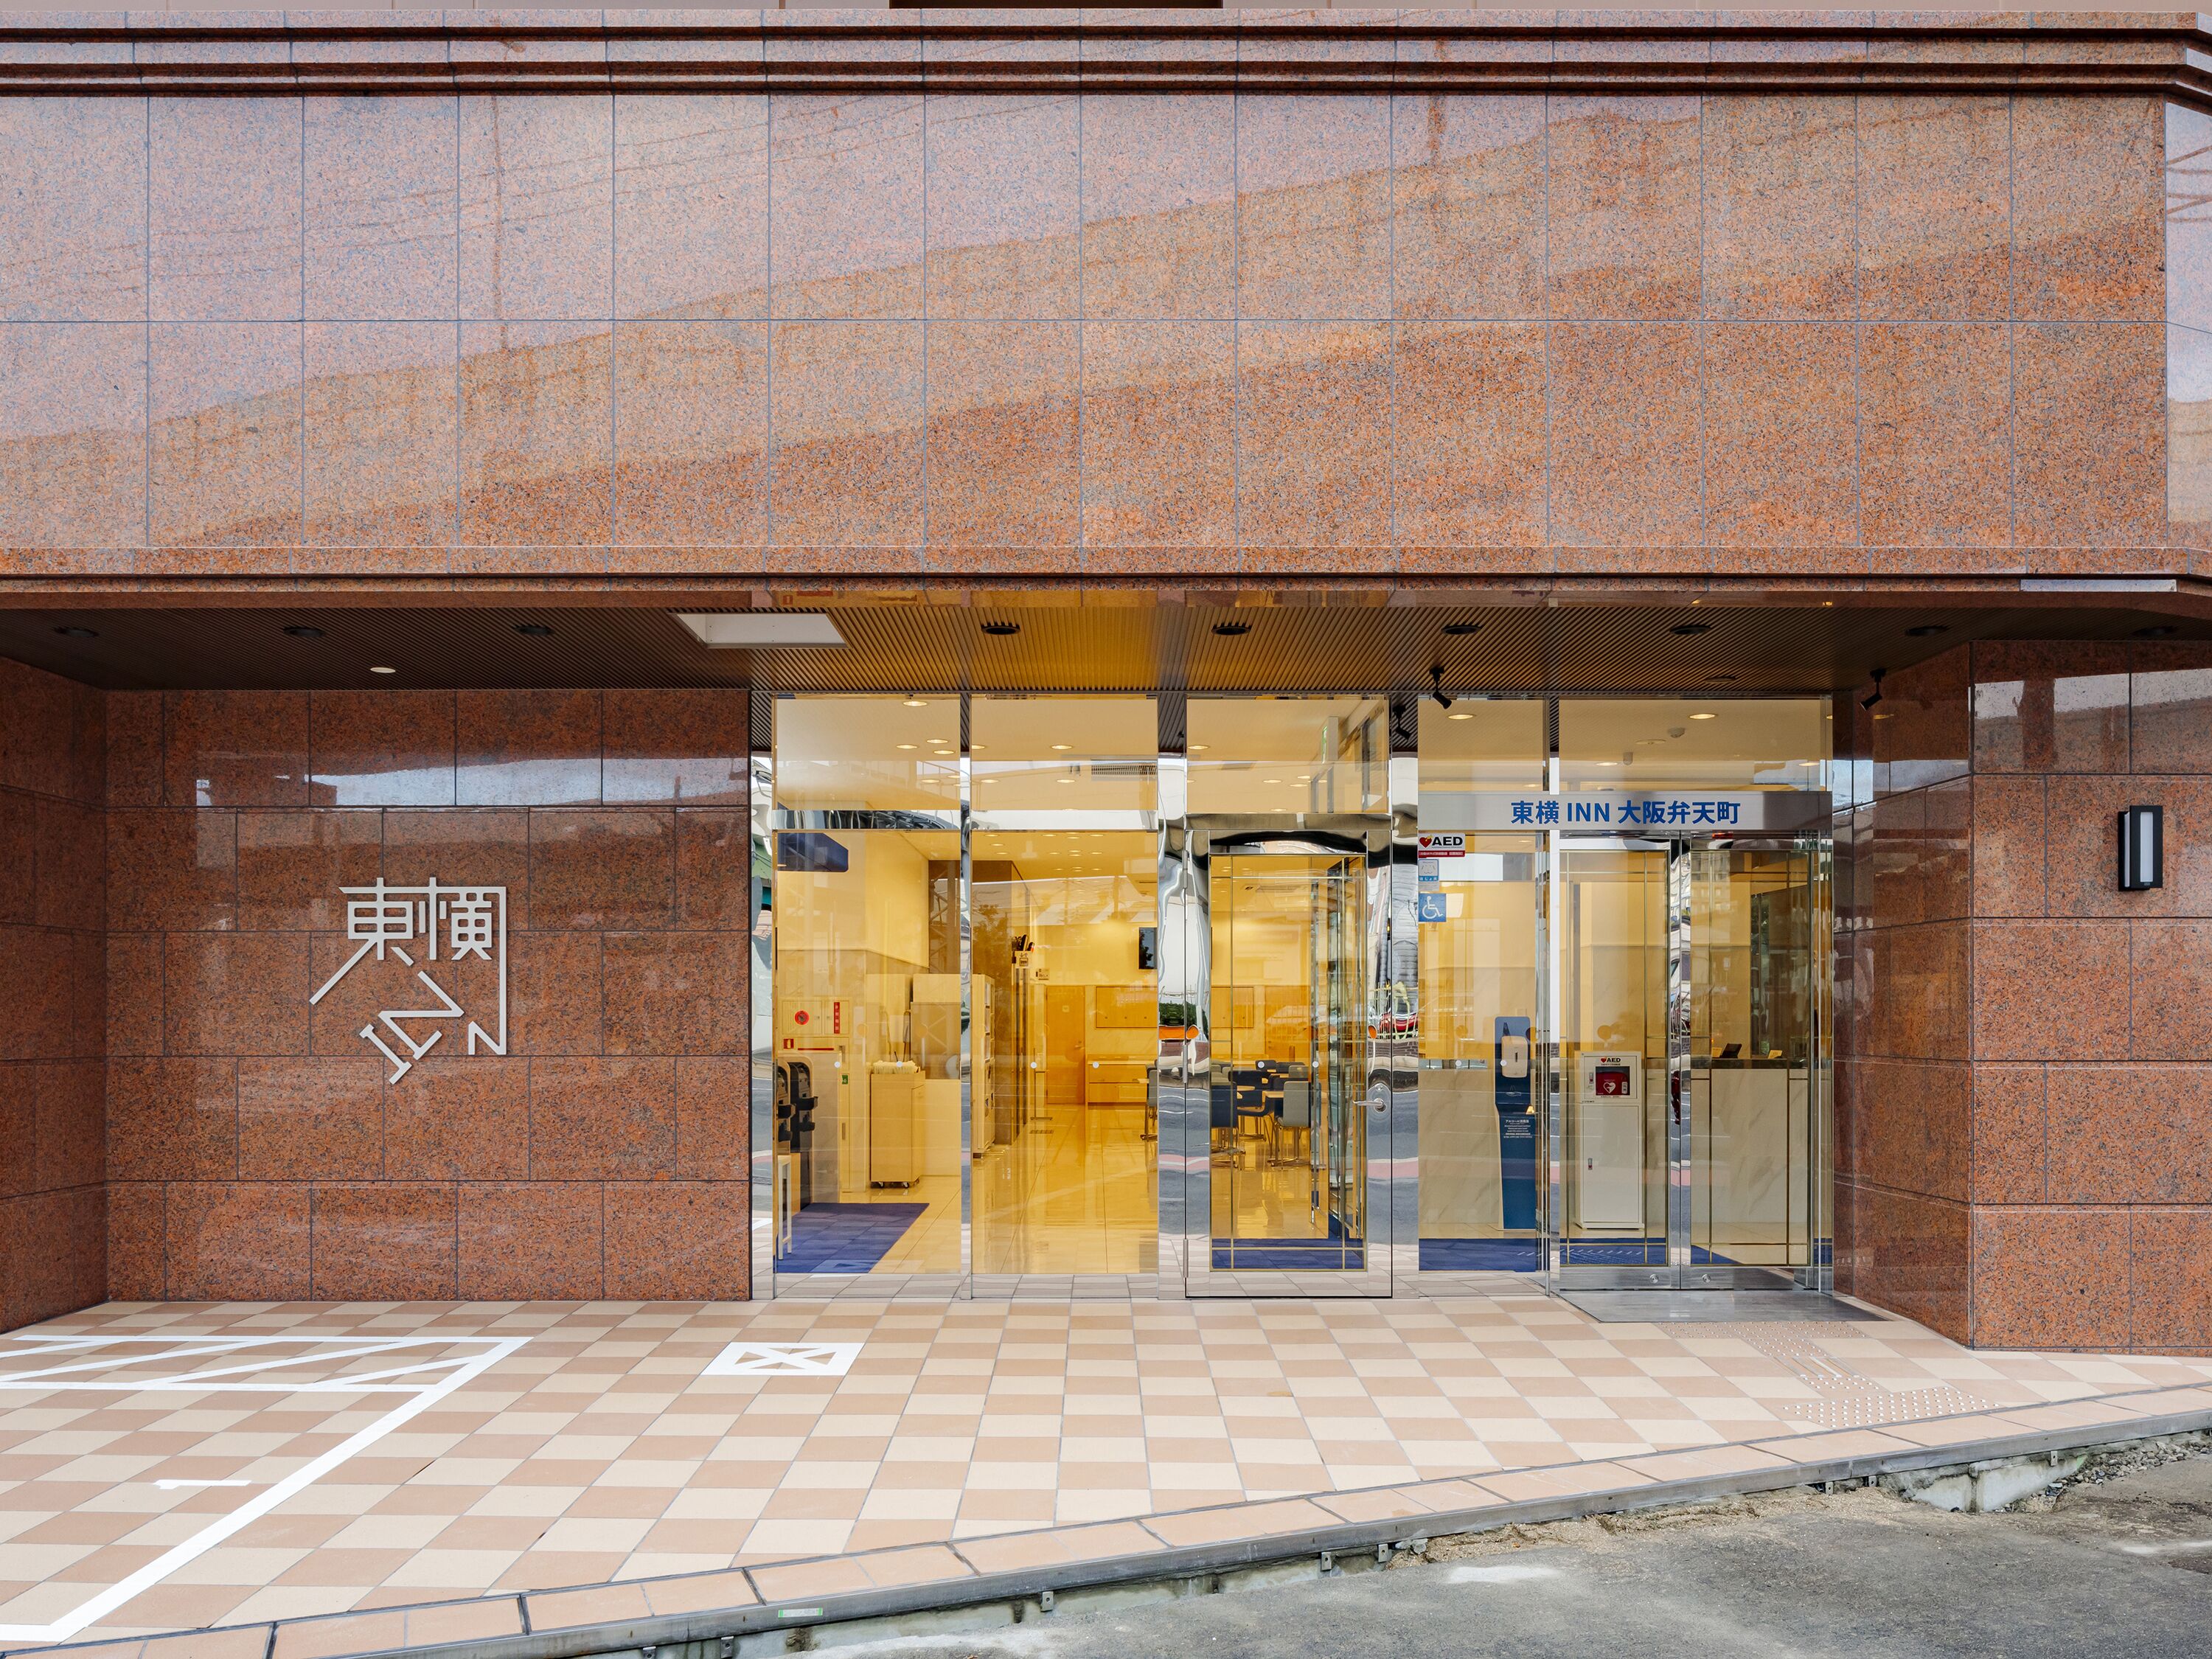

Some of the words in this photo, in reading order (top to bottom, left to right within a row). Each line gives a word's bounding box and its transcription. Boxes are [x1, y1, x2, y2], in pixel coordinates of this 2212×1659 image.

[1511, 800, 1559, 824] 東横
[1567, 802, 1610, 822] INN
[1618, 800, 1741, 824] 大阪弁天町
[1432, 836, 1463, 846] AED
